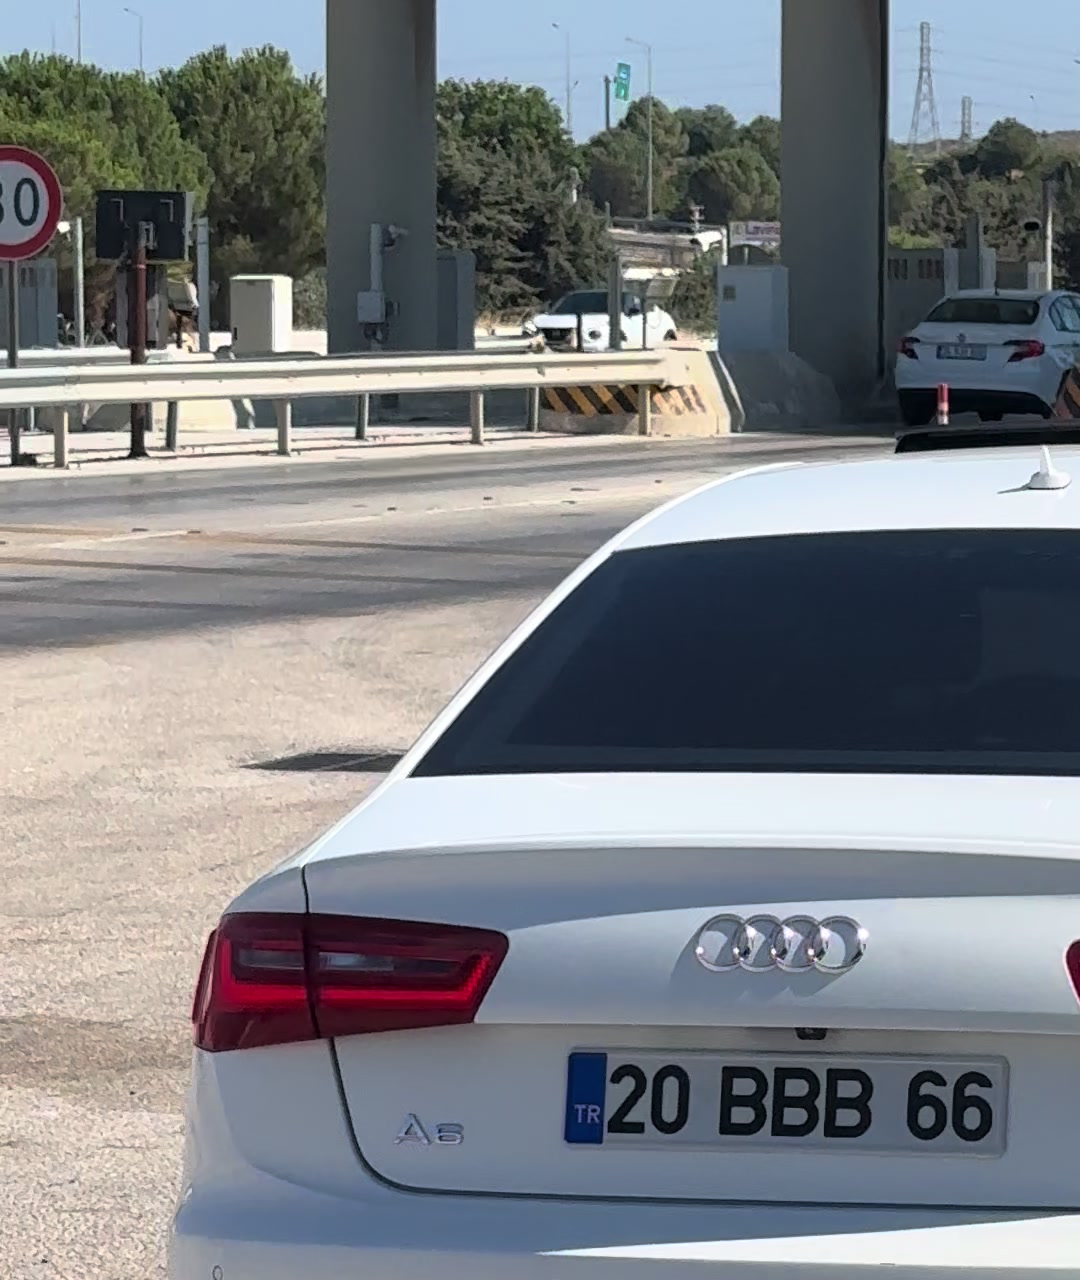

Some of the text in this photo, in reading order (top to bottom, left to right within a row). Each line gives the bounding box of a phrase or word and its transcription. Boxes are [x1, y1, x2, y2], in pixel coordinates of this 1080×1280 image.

[0, 177, 40, 227] 0
[574, 1103, 601, 1124] TR
[608, 1064, 993, 1142] 20 BBB 66
[393, 1112, 464, 1145] A6
